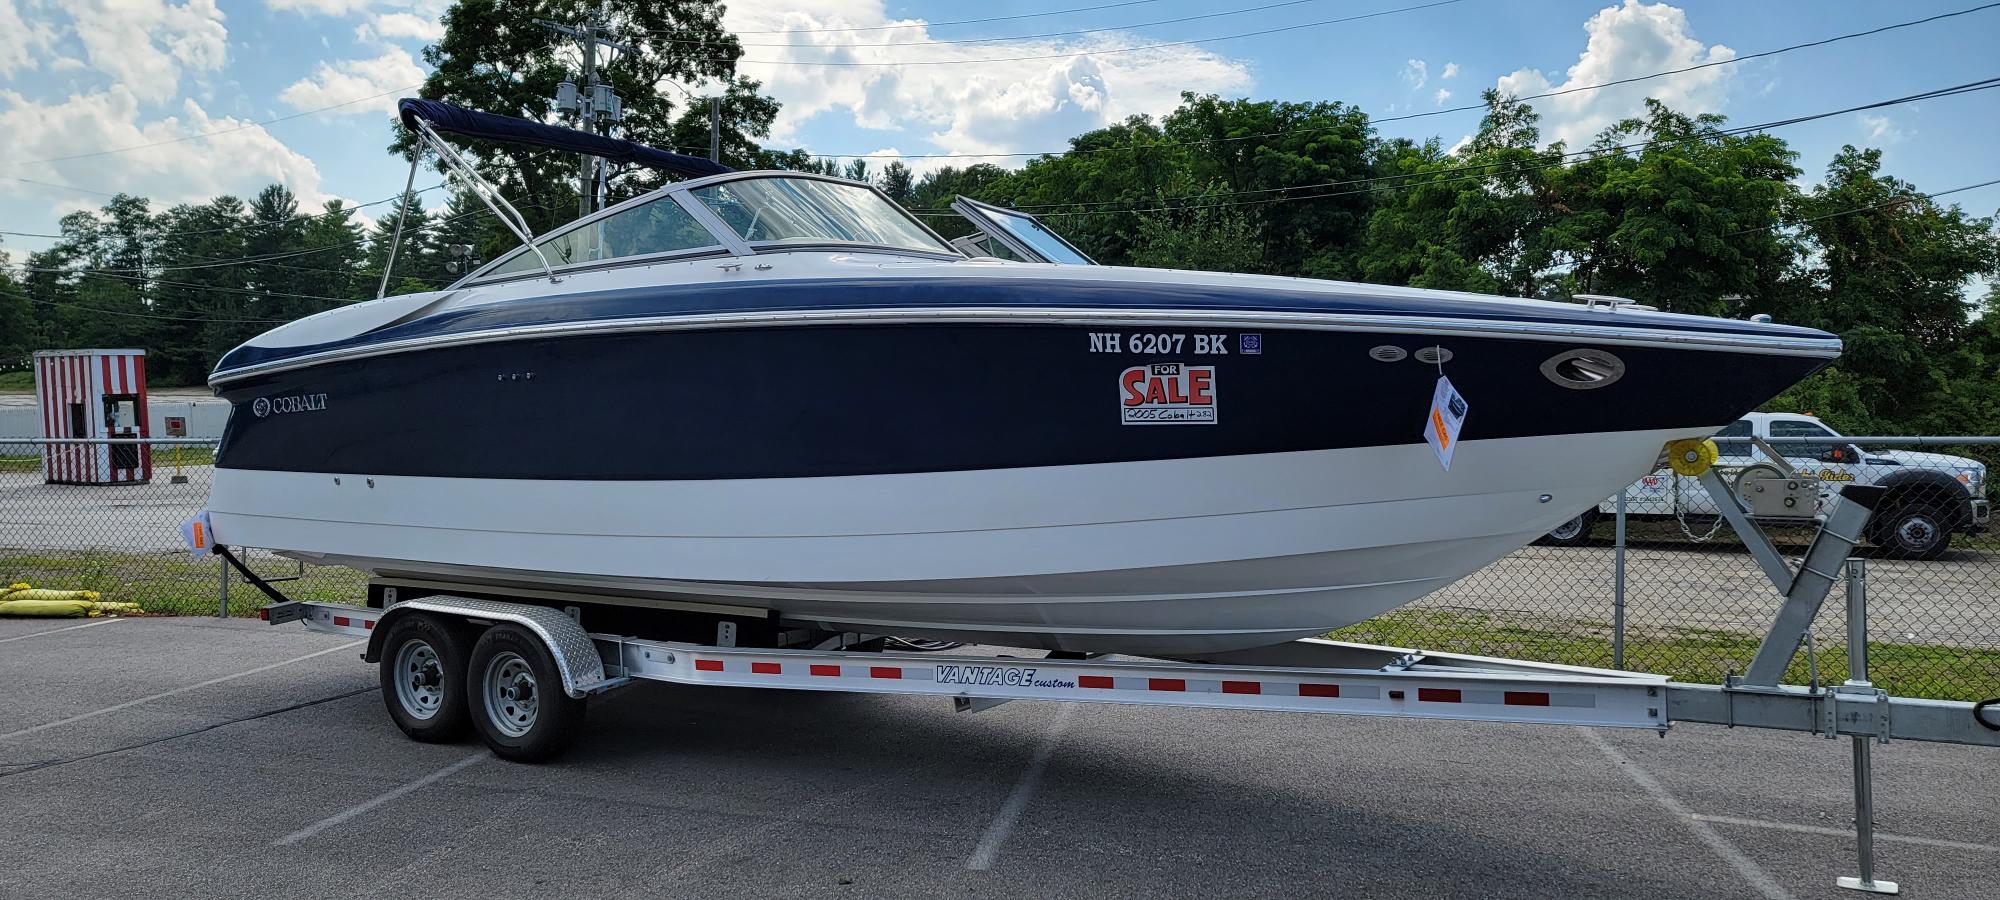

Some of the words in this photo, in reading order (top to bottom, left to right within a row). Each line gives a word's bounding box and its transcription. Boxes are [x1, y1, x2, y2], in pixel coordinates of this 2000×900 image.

[1088, 332, 1122, 353] NH
[1128, 333, 1186, 355] 6207
[1193, 334, 1229, 355] BK
[1154, 365, 1178, 375] FOR
[1122, 369, 1213, 407] SALE
[273, 393, 328, 414] COBALT
[1126, 408, 1158, 420] 2005
[936, 665, 1037, 687] VANTAGE
[1034, 678, 1076, 689] custom
